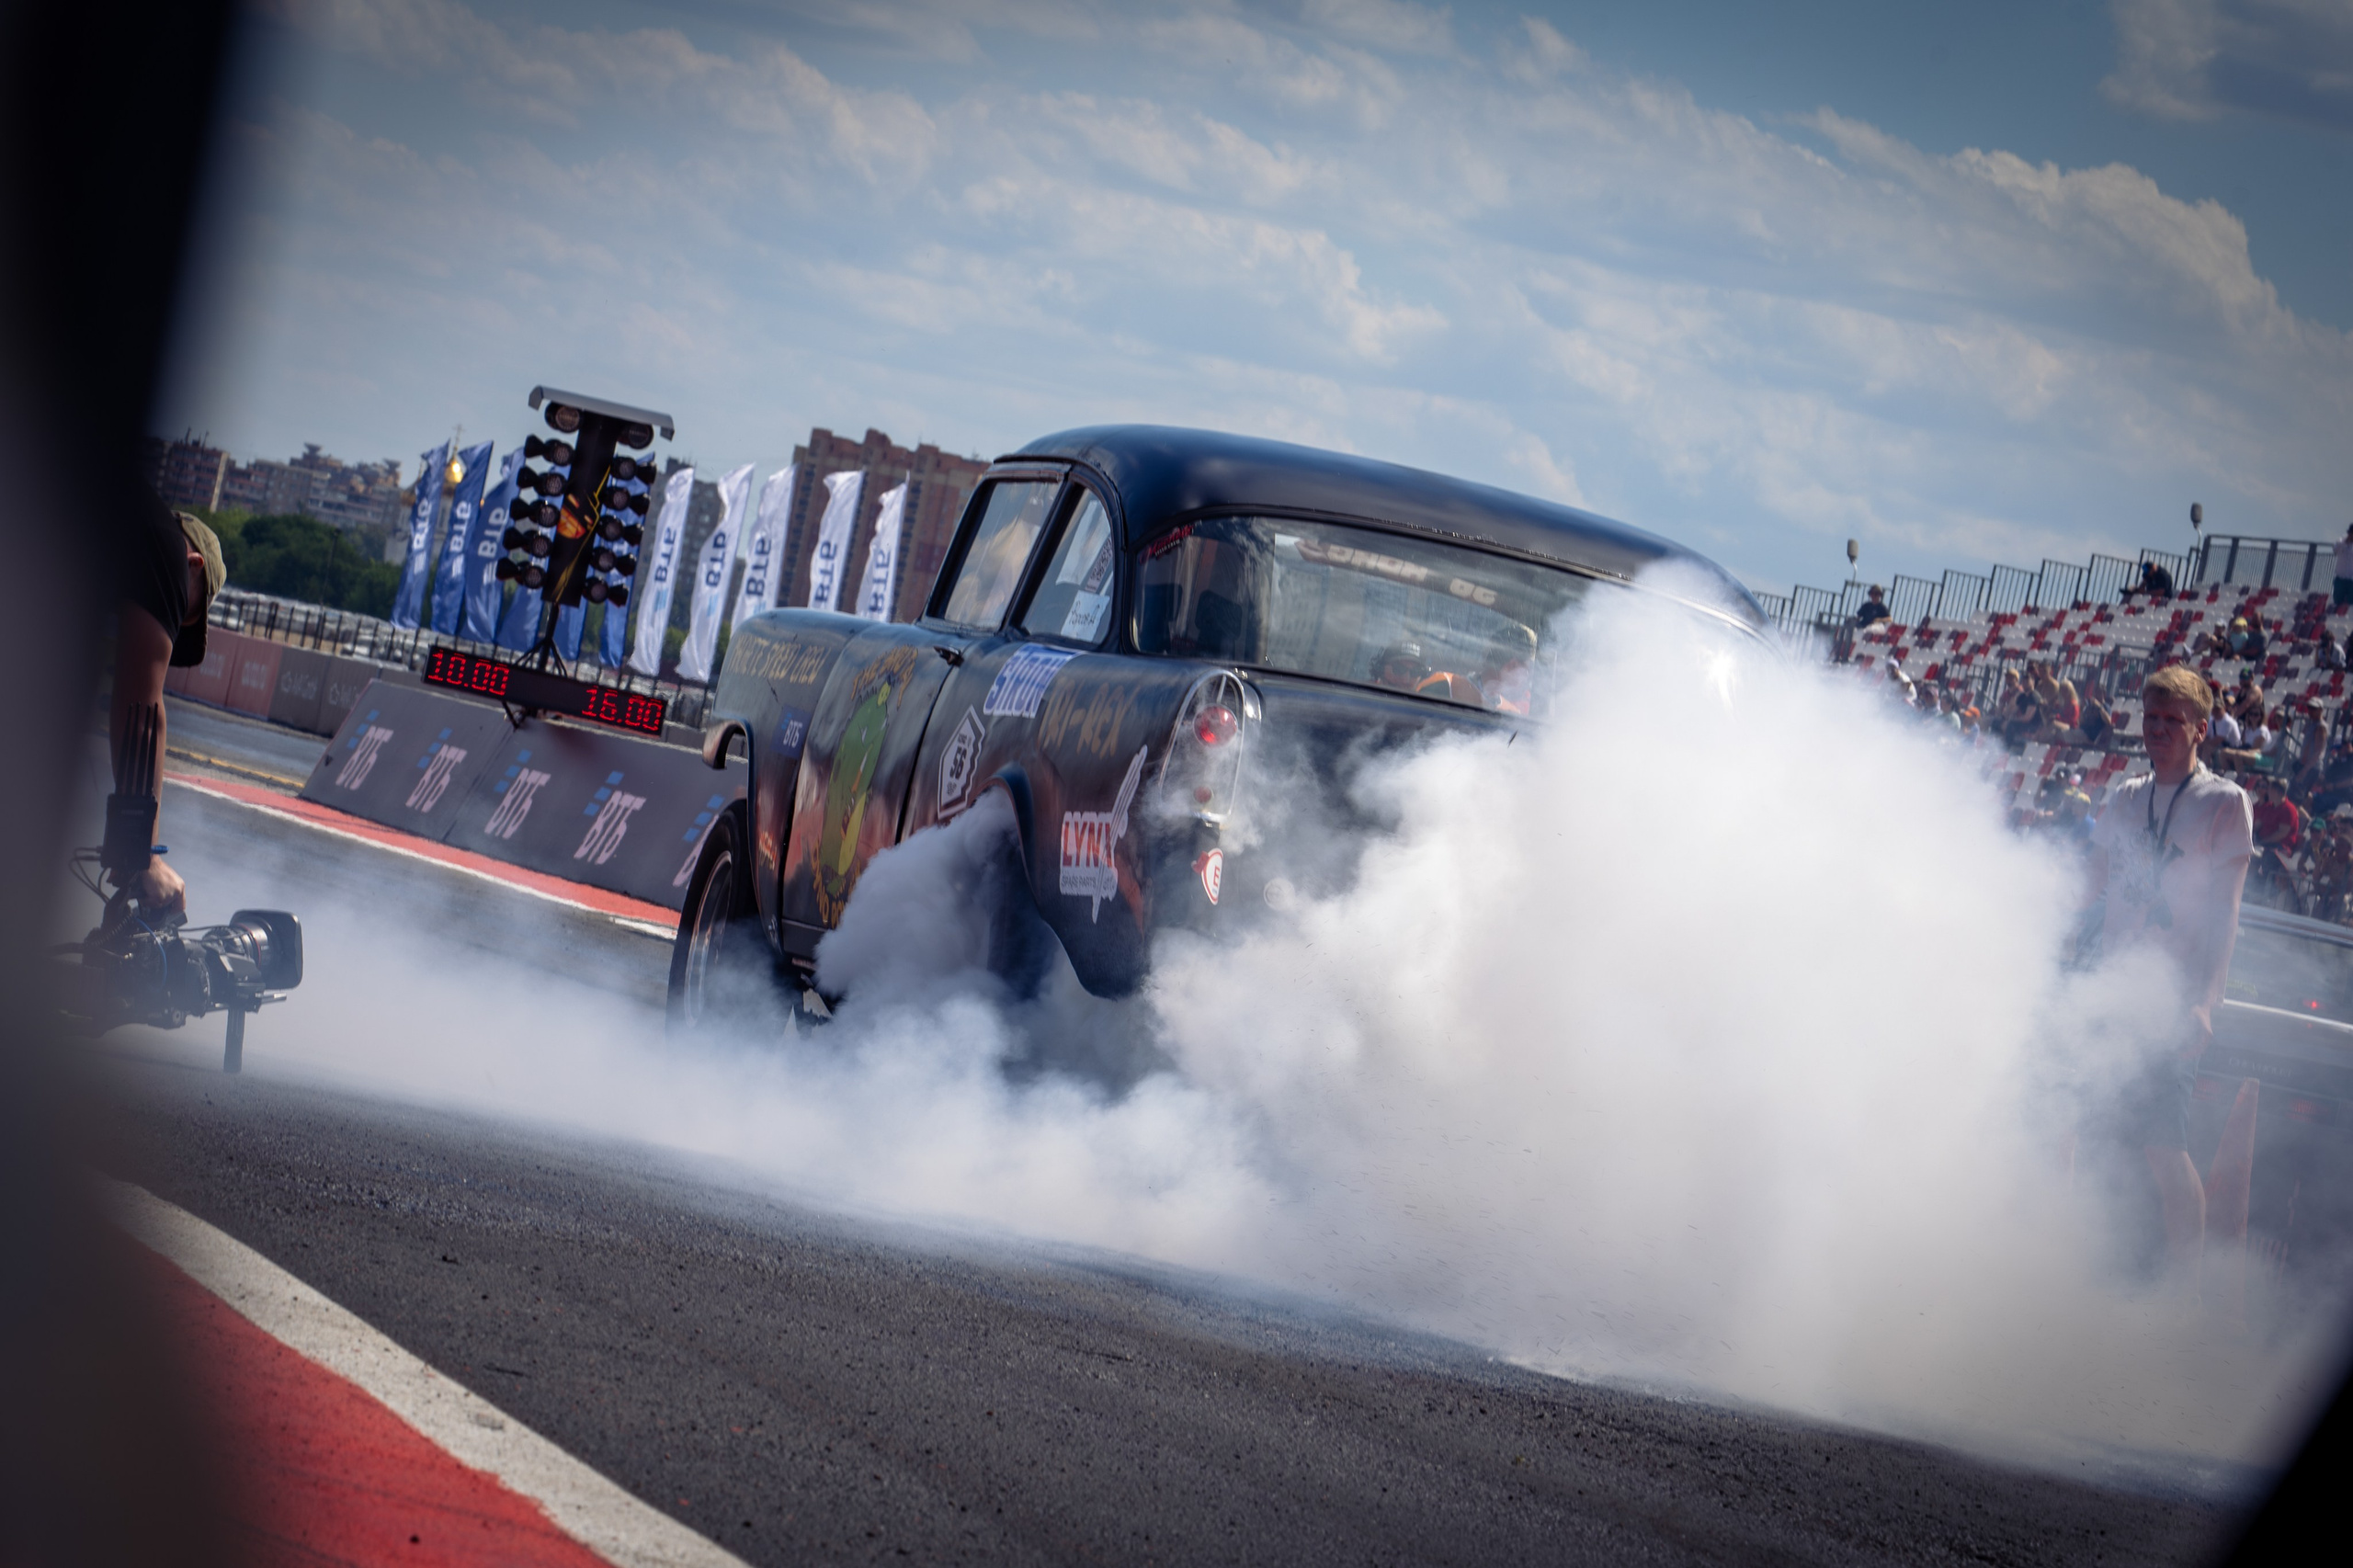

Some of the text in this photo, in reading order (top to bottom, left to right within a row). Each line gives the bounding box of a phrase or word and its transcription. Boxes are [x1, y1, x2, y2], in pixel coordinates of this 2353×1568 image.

[427, 649, 510, 697] 10.00
[581, 687, 664, 732] 16.00
[783, 719, 803, 748] ВТБ
[335, 725, 394, 790] ВТБ
[405, 744, 468, 813] ВТБ
[949, 746, 968, 779] 56
[484, 767, 551, 840] ВТБ
[574, 790, 647, 865] ВТБ
[1063, 821, 1114, 869] LYNX
[1212, 865, 1221, 888] E
